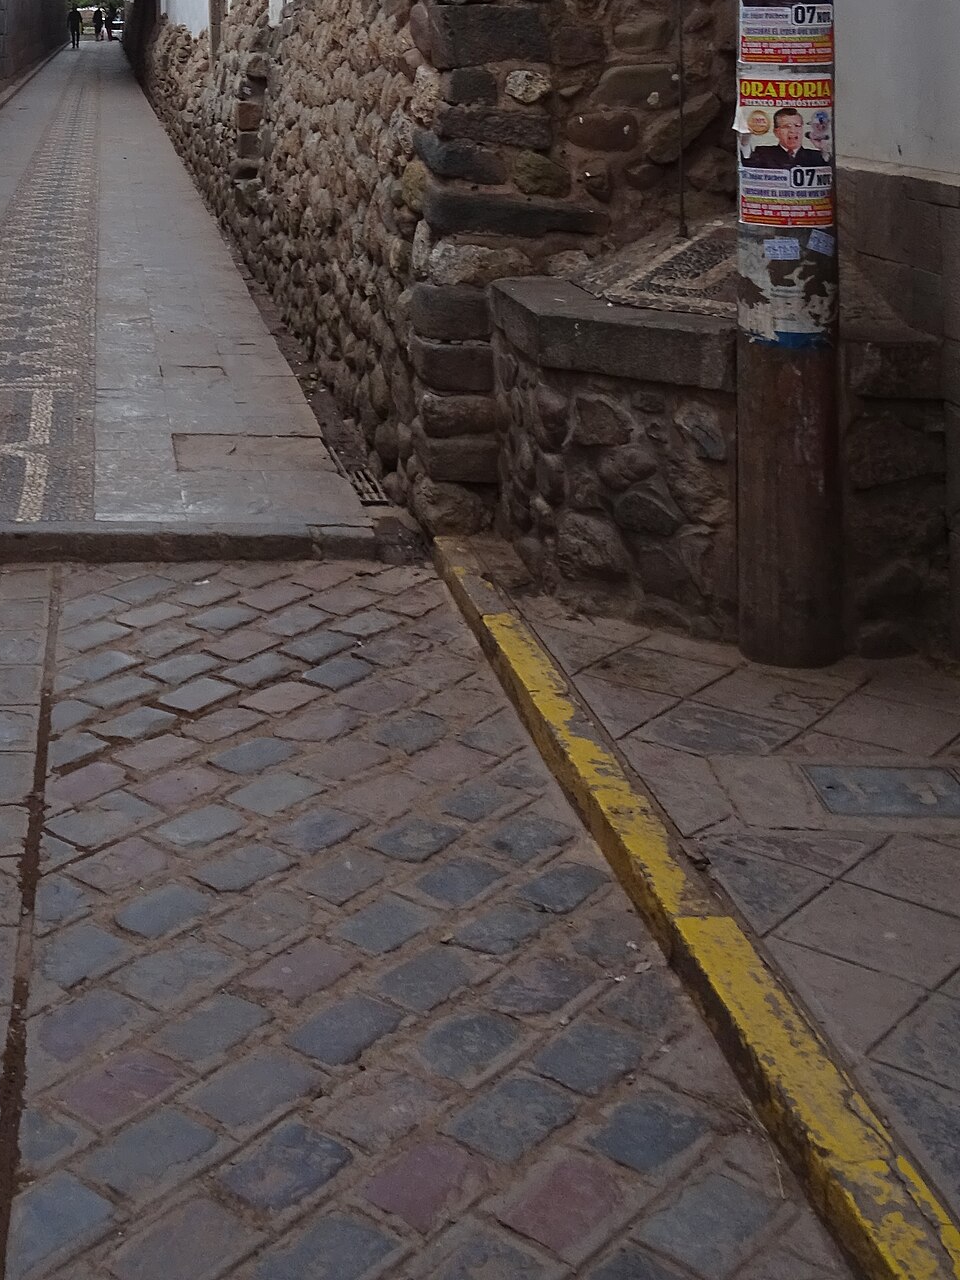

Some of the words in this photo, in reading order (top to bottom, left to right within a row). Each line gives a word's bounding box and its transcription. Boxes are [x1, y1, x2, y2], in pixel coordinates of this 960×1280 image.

[794, 6, 816, 24] 07
[741, 82, 830, 98] ORATORIA
[793, 169, 815, 187] 07
